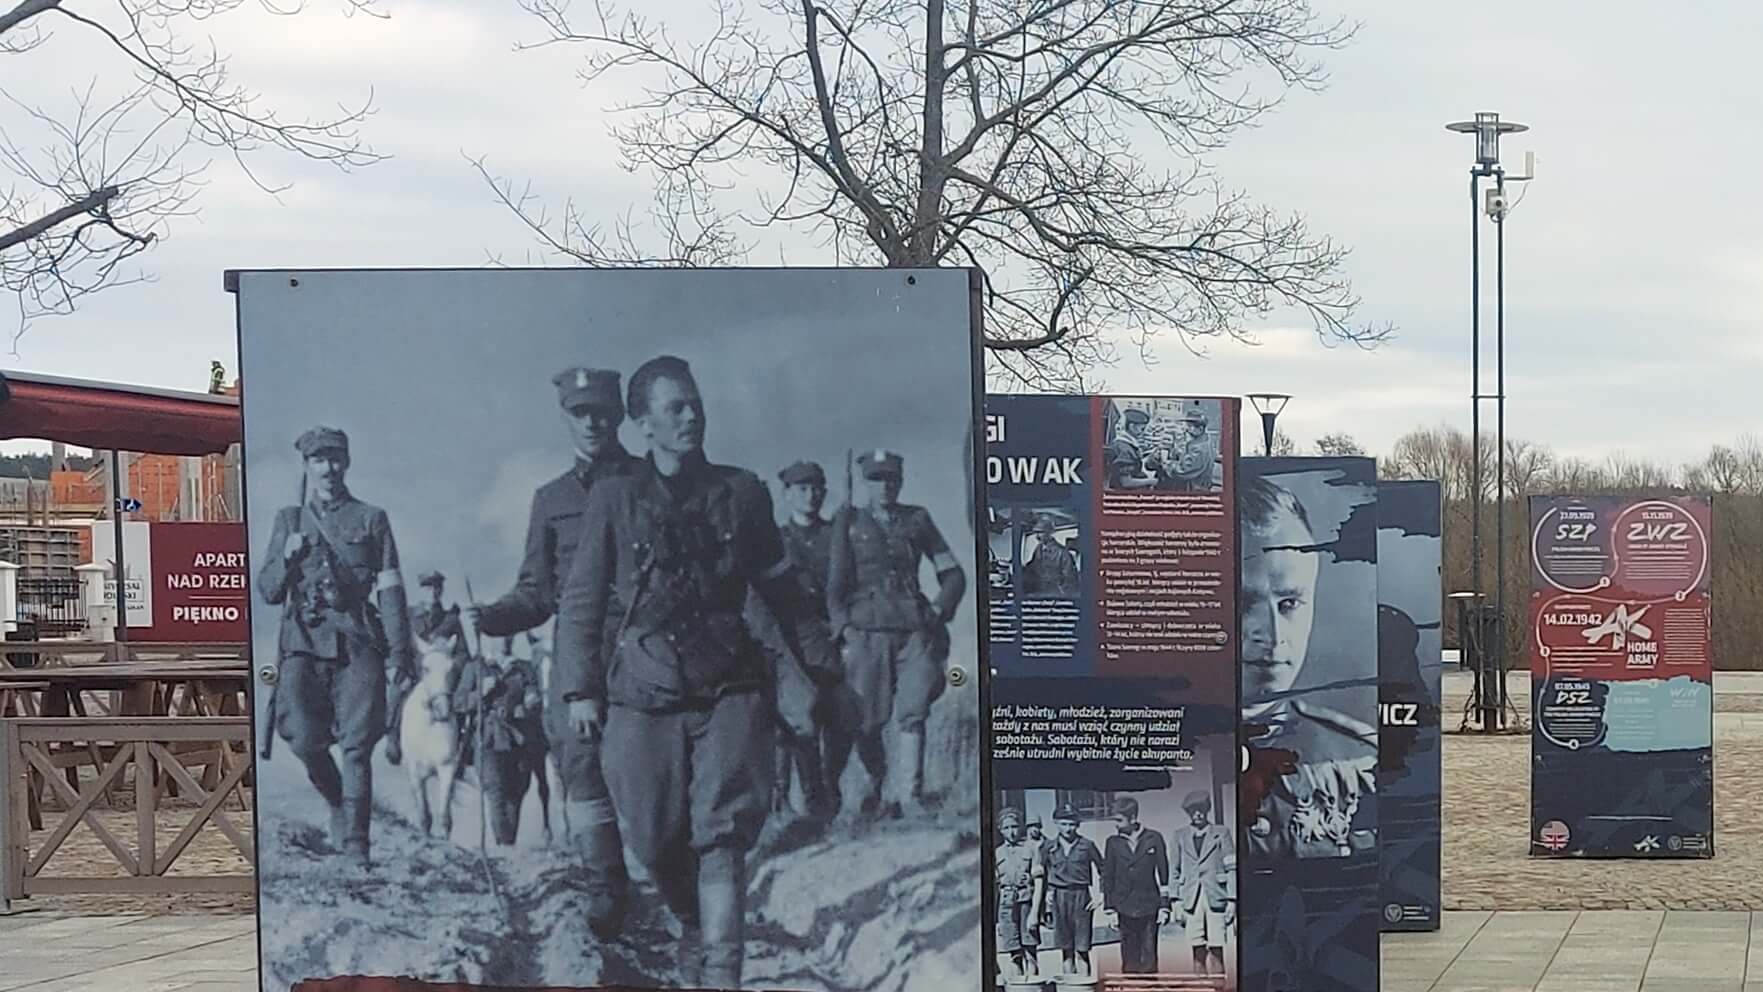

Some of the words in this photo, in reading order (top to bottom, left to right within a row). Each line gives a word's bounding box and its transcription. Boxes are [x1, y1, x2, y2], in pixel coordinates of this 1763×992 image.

[1042, 457, 1083, 484] AK
[1555, 522, 1597, 541] SZP
[194, 552, 245, 567] APART
[168, 573, 204, 589] NAD
[174, 605, 239, 624] PIĘKNO
[1544, 613, 1602, 625] 14.02.1942
[1627, 641, 1658, 652] HOME
[1627, 654, 1659, 665] ARMY
[1059, 706, 1108, 721] młodzież,
[1109, 707, 1185, 721] zorganizowani
[1022, 722, 1030, 730] z
[1031, 723, 1050, 731] nas
[1052, 720, 1078, 731] musi
[1148, 720, 1181, 731] udział
[1129, 731, 1146, 745] nie
[1026, 746, 1066, 759] utrudni
